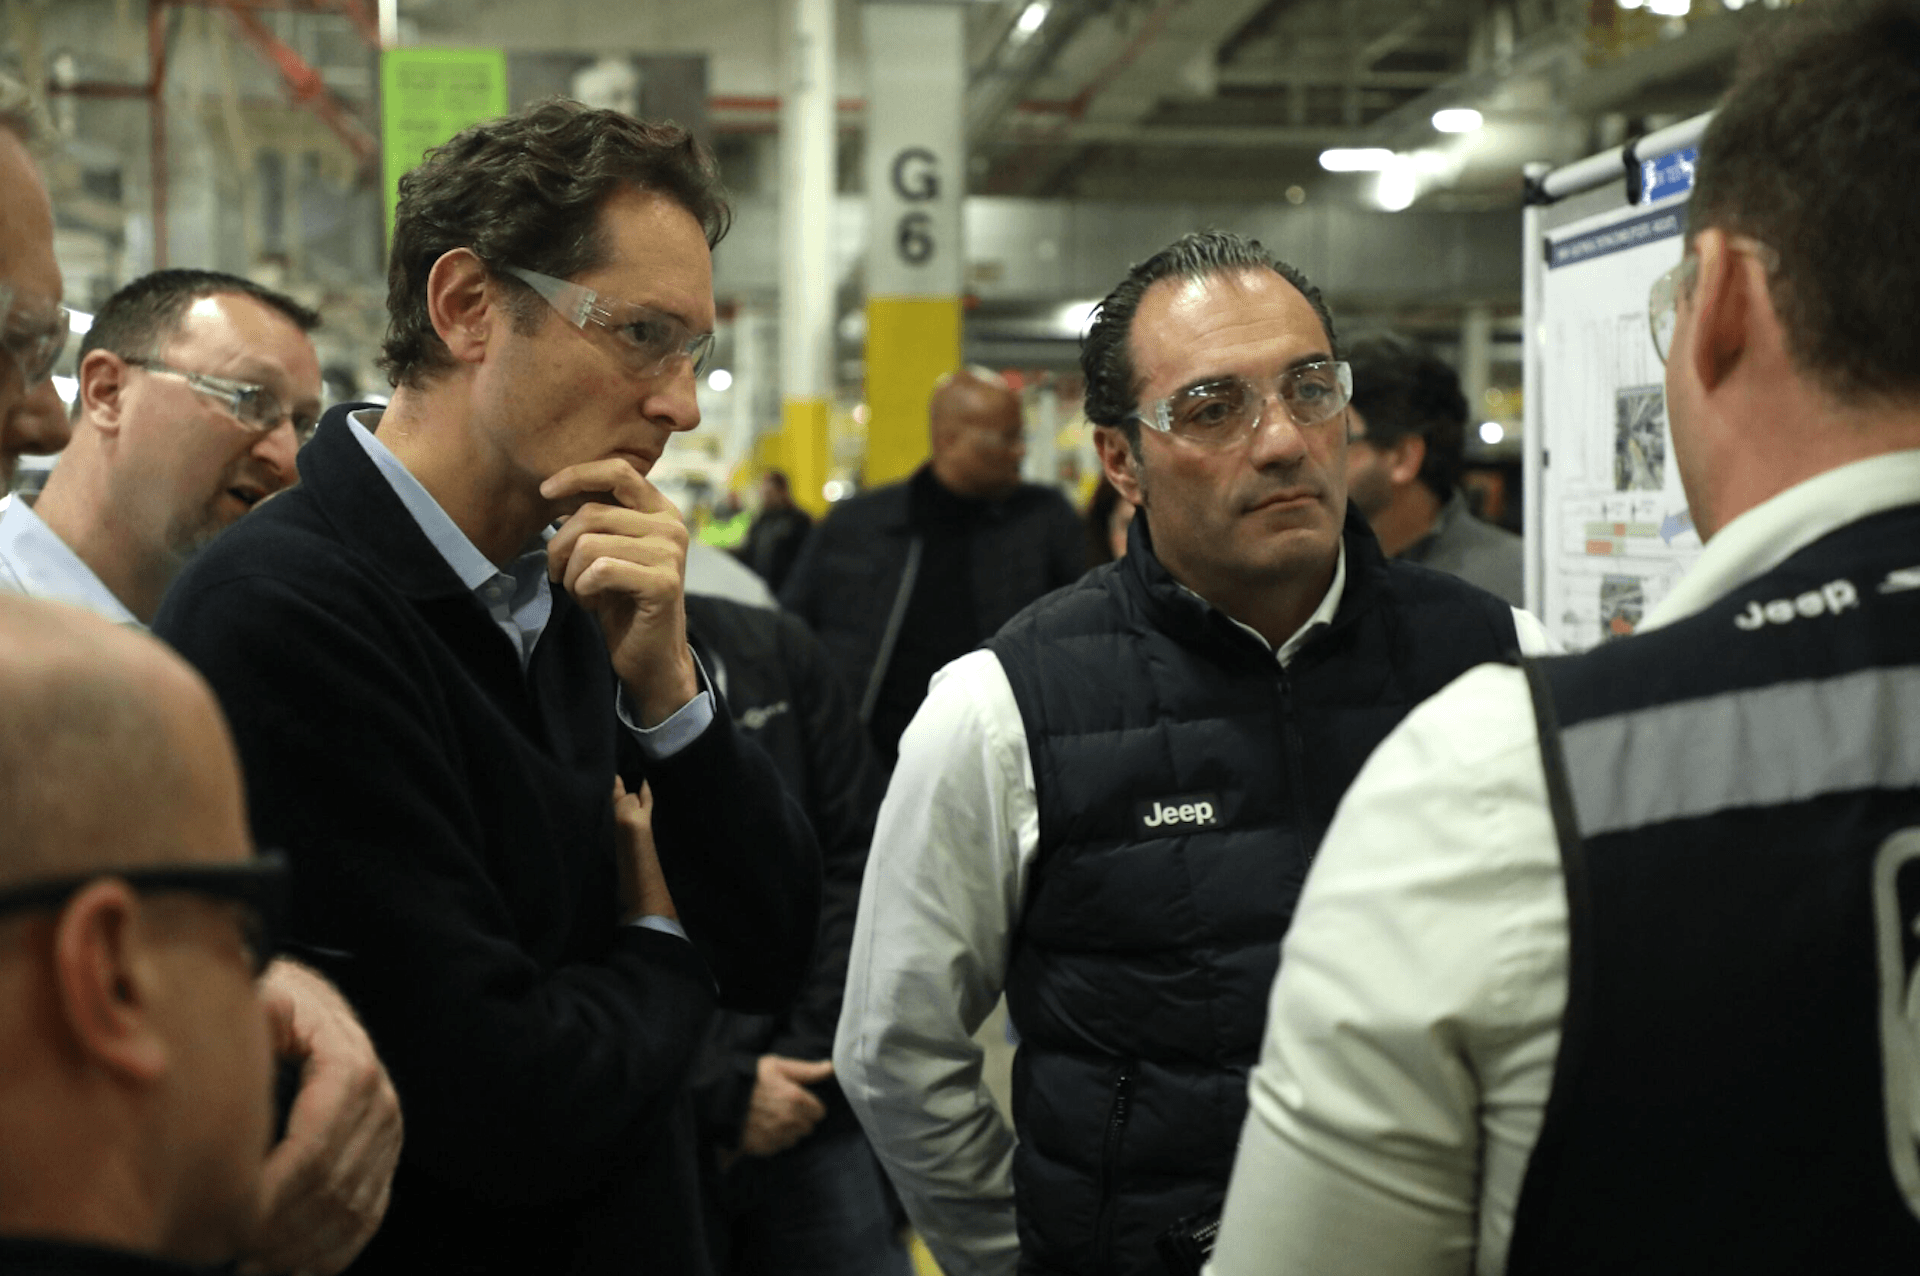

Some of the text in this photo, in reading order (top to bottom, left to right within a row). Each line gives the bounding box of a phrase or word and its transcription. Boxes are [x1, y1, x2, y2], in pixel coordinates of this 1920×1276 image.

[890, 146, 940, 201] G
[896, 211, 934, 267] 6
[1734, 578, 1857, 630] Jeep
[1143, 801, 1214, 827] Jeep
